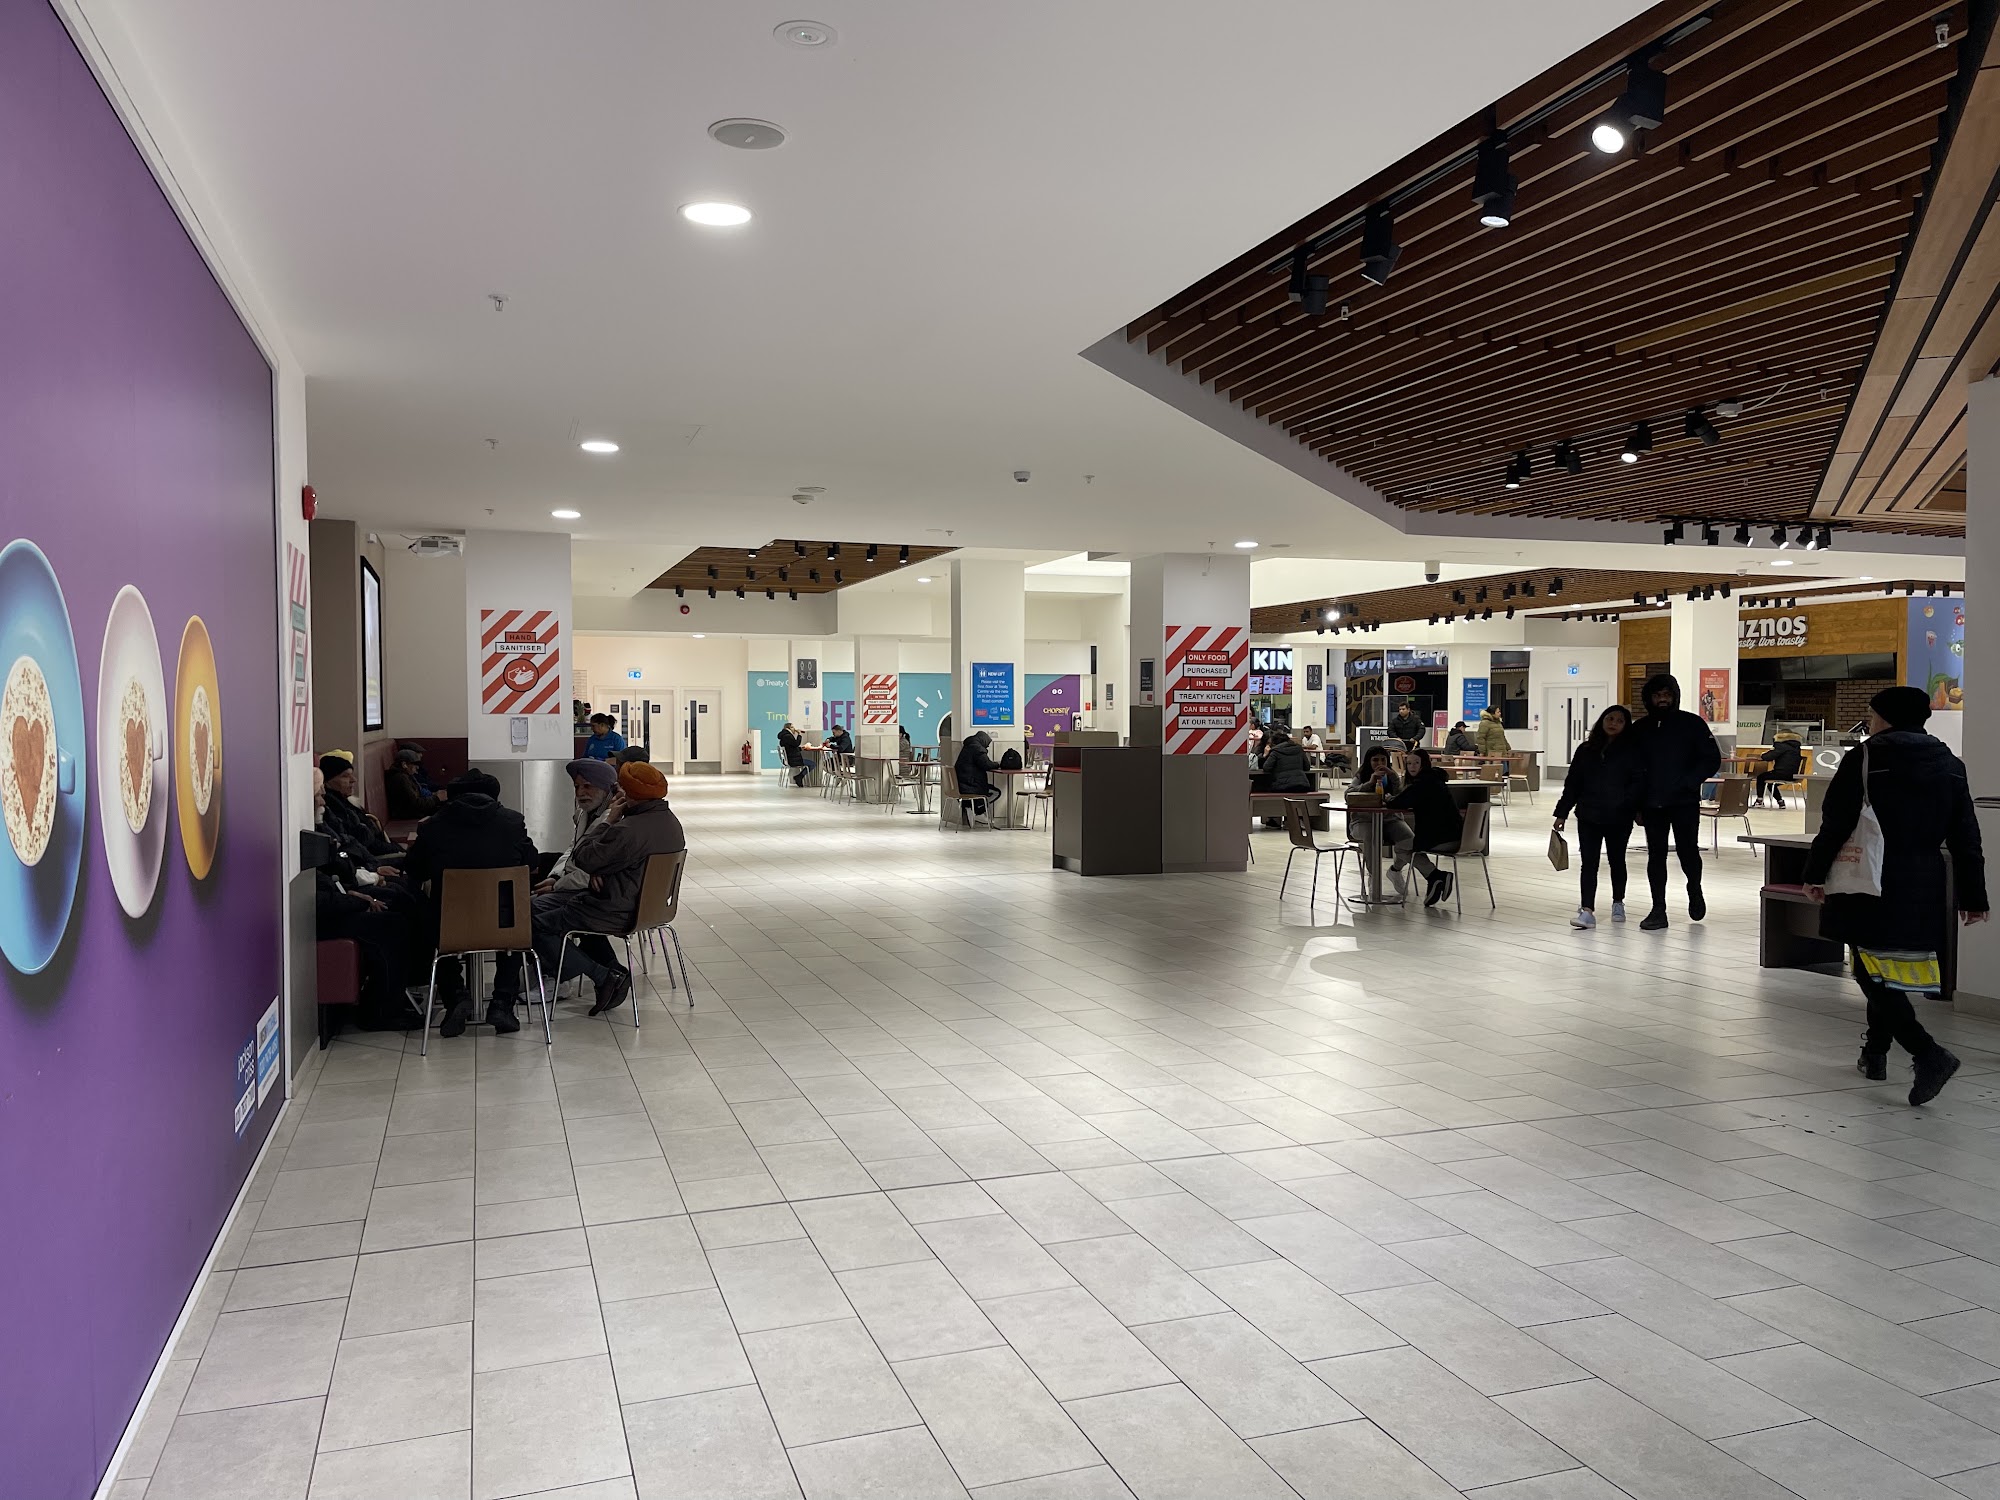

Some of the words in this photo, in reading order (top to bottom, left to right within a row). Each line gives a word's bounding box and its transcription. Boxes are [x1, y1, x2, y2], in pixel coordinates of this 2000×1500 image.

[1758, 637, 1775, 647] live
[1777, 635, 1806, 648] toasty
[1254, 650, 1292, 670] KIN
